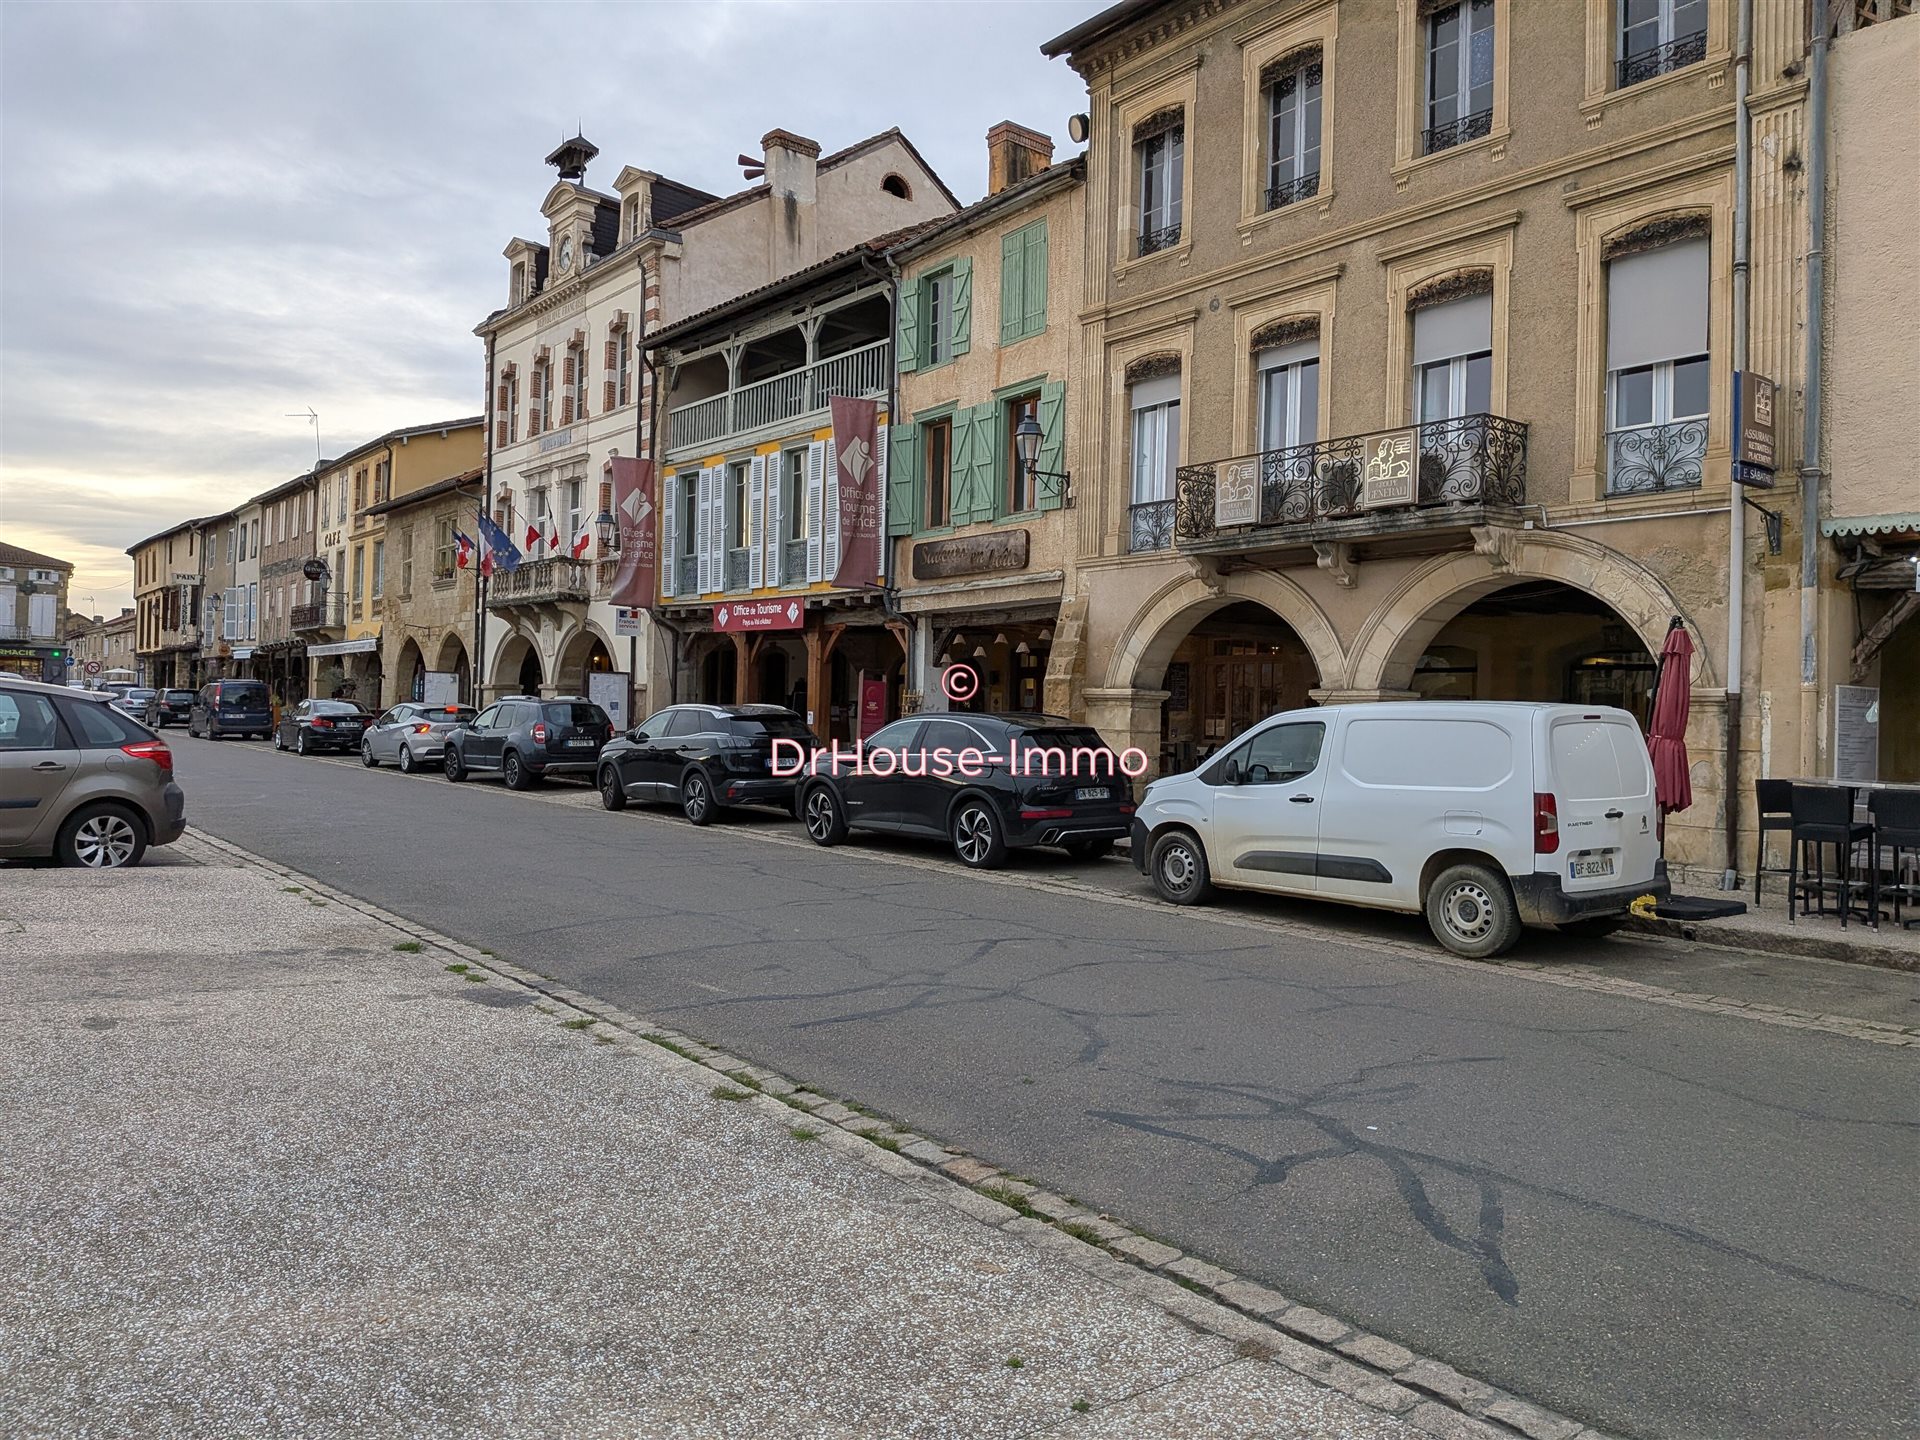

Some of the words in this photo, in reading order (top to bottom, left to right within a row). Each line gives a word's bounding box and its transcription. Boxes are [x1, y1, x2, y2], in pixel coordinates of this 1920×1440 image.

[865, 491, 876, 501] de
[1368, 485, 1407, 499] GENERALI
[645, 530, 654, 538] de
[733, 603, 750, 616] Office
[750, 606, 756, 615] de
[756, 602, 782, 615] Tourisme
[742, 618, 751, 627] Pays
[1567, 820, 1593, 828] PARTNER
